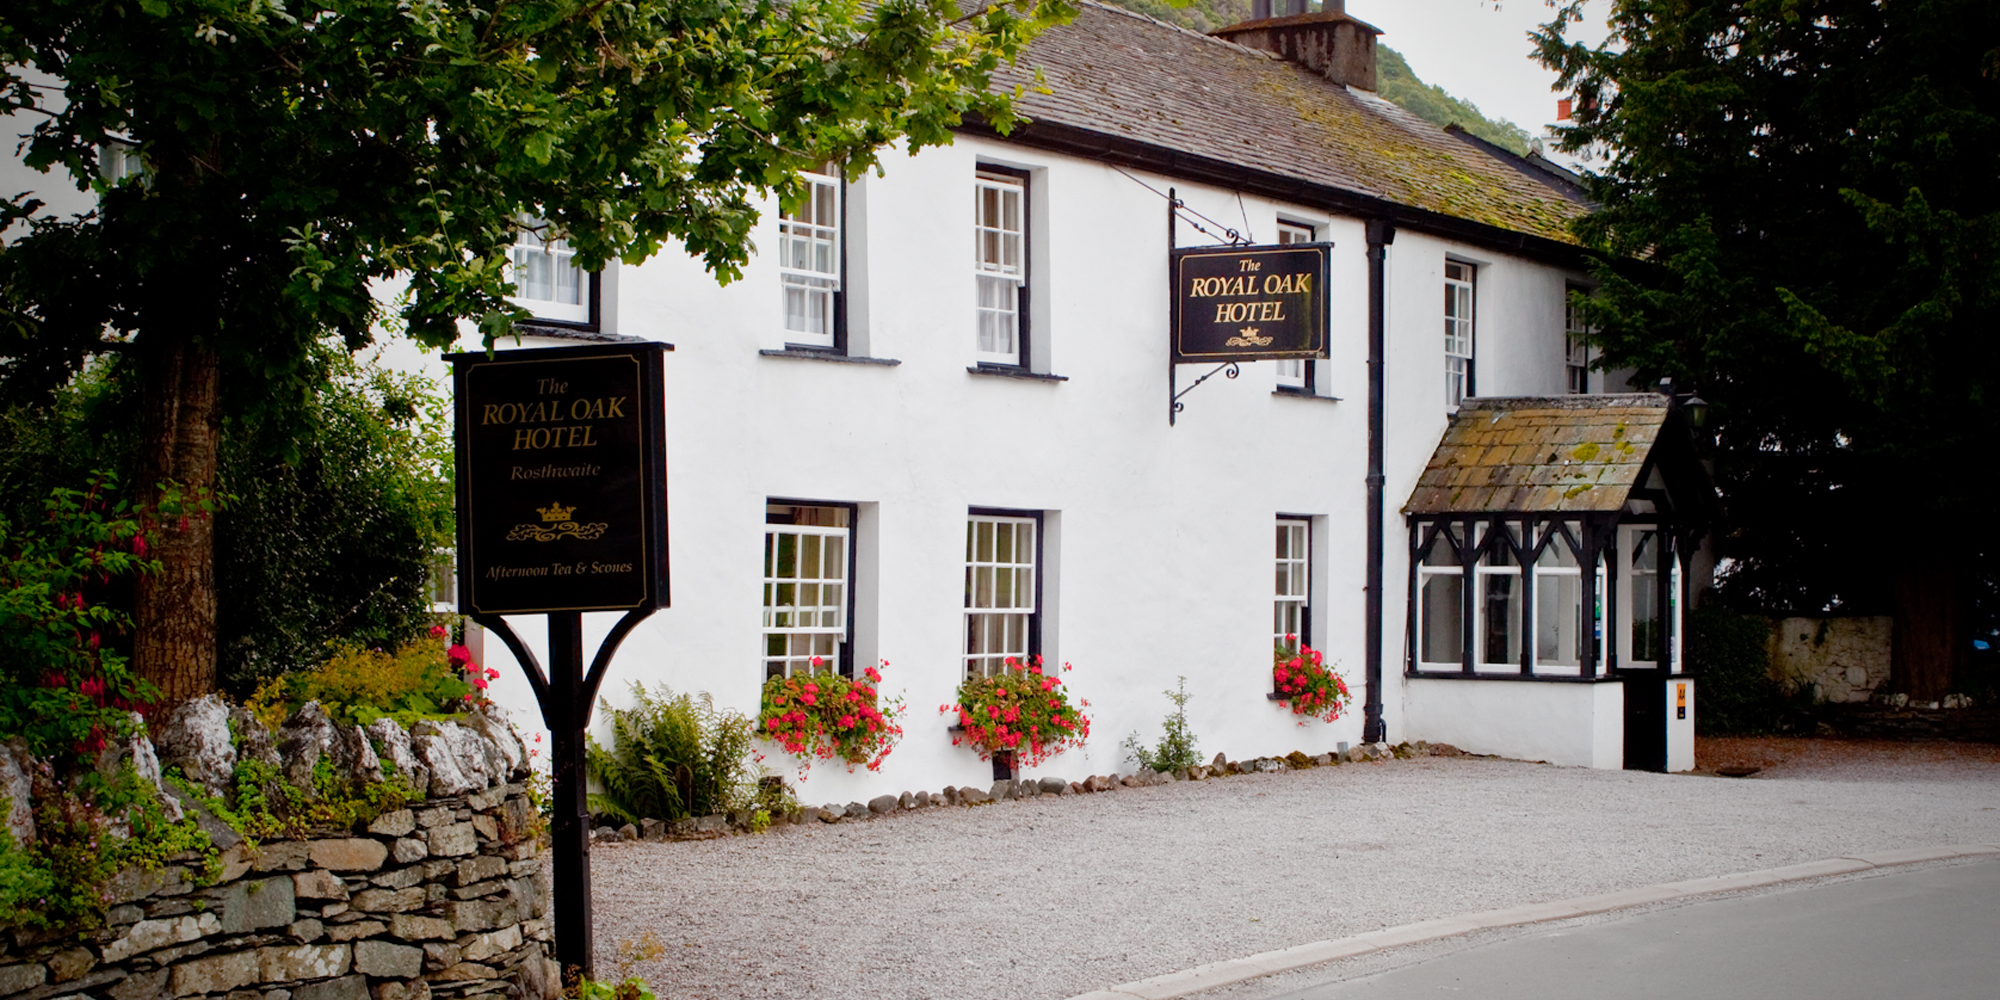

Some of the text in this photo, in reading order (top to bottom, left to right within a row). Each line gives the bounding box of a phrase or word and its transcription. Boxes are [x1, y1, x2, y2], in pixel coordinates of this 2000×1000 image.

[1239, 259, 1261, 272] The
[1189, 273, 1312, 298] ROYAL OAK
[1214, 301, 1286, 323] HOTEL
[536, 378, 569, 395] The
[481, 396, 627, 426] ROYAL OAK
[512, 425, 598, 450] HOTEL
[511, 462, 601, 480] Rosthwaite
[485, 561, 633, 582] Afternoon Tea & Scones
